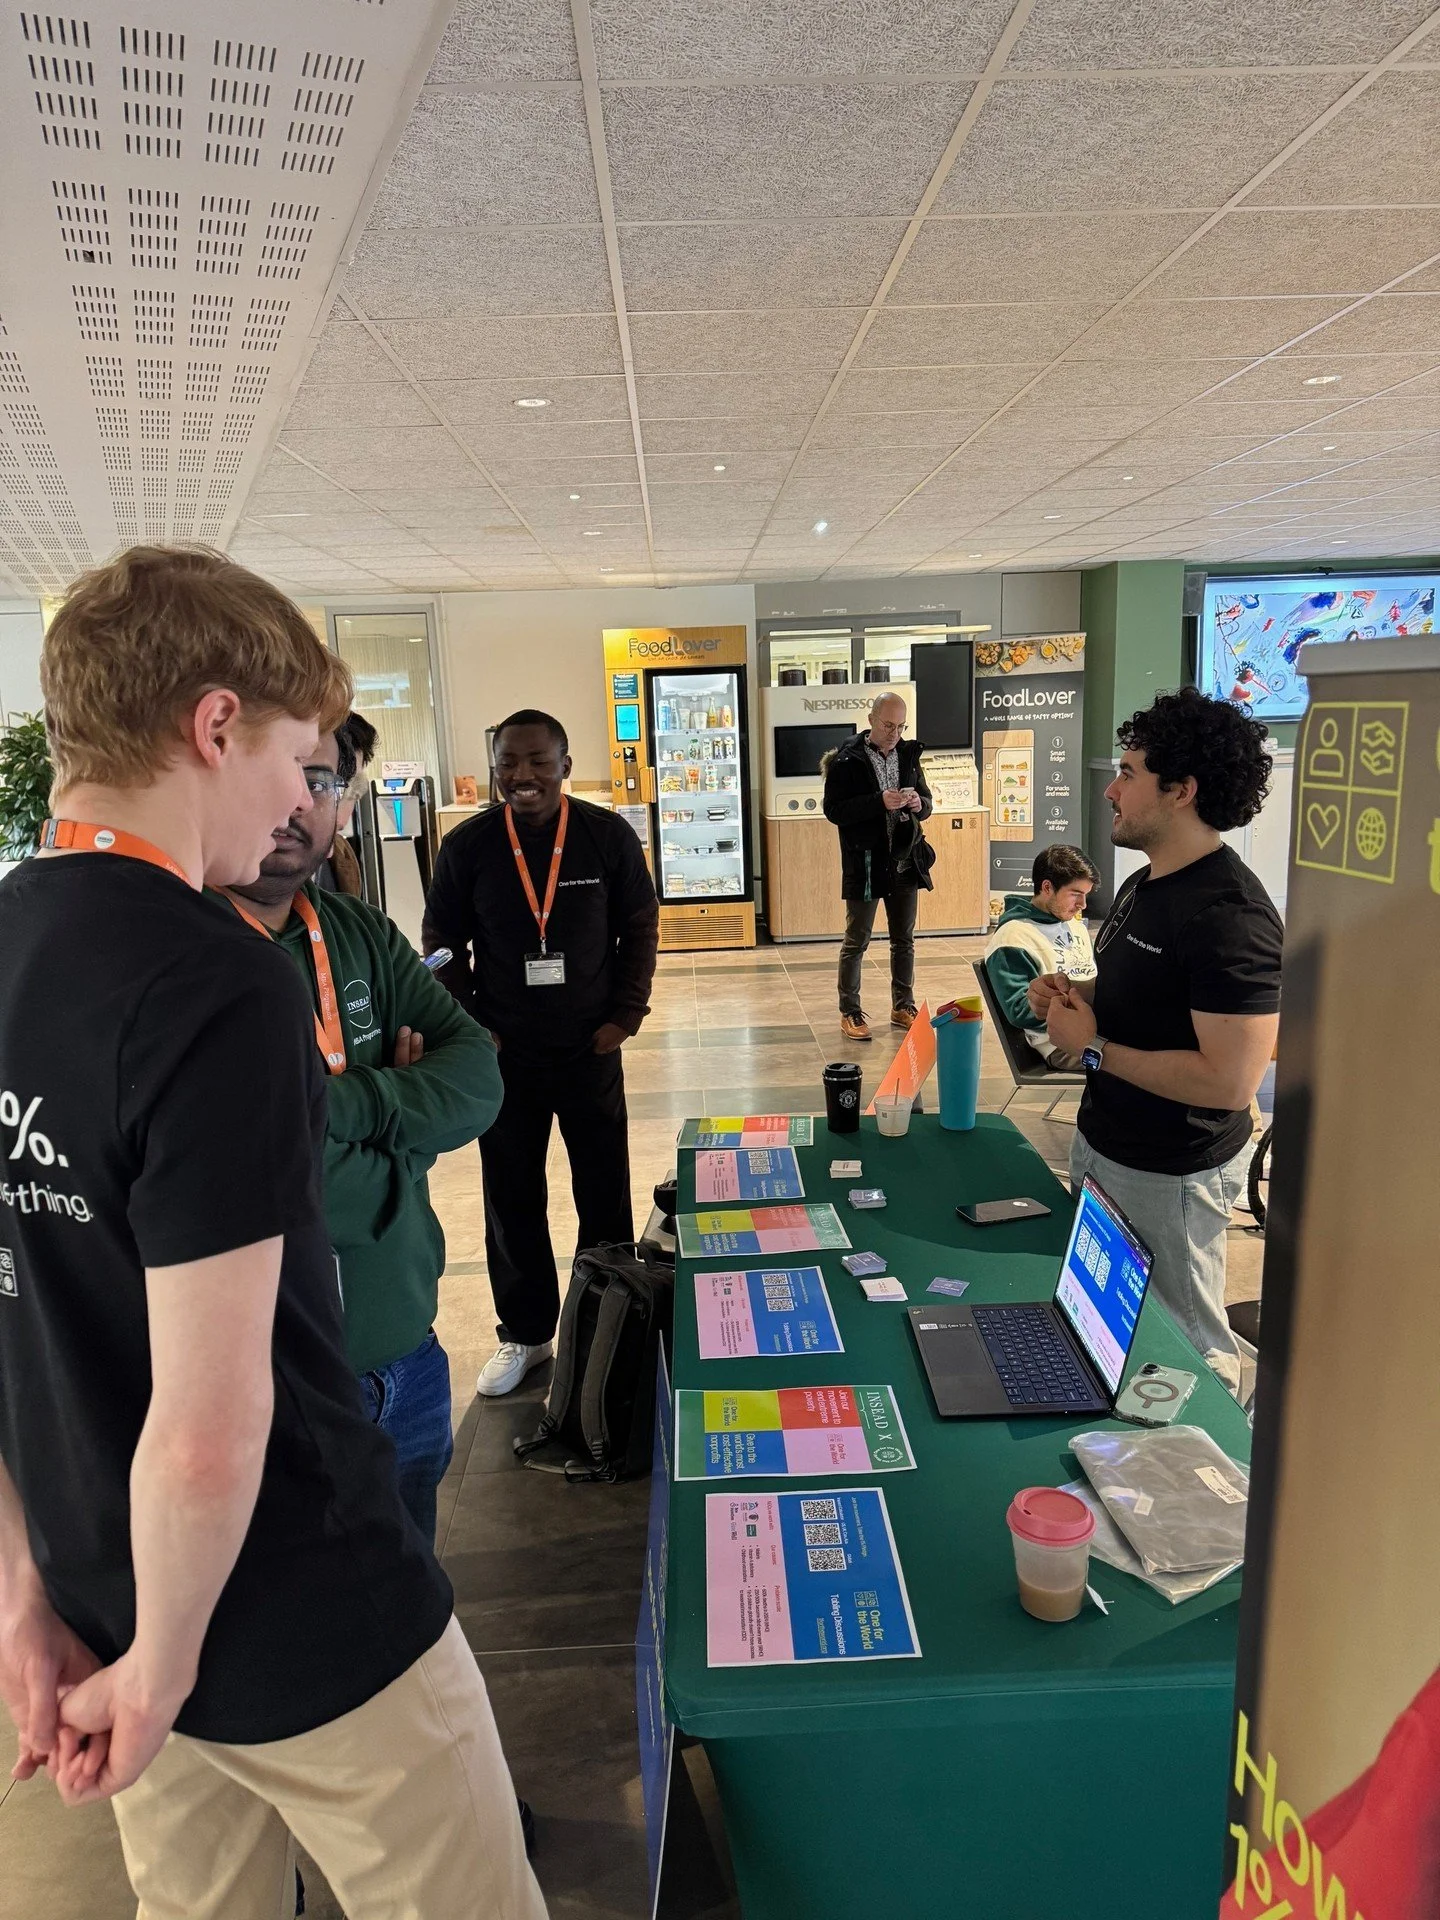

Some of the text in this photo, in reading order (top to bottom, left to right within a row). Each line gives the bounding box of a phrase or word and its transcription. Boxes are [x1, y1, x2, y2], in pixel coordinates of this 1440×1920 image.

[629, 635, 721, 657] FoodLover
[800, 697, 876, 714] NESPRESSO
[983, 688, 1076, 709] FoodLover
[1024, 713, 1032, 721] OF
[1050, 712, 1075, 720] OPTIONS
[1146, 943, 1162, 954] World
[347, 996, 370, 1011] INSEAD
[814, 1207, 832, 1227] INSEAD
[800, 1330, 812, 1349] the World
[810, 1329, 819, 1338] One
[730, 1406, 738, 1415] One
[804, 1391, 816, 1412] poverty
[816, 1391, 830, 1424] end extreme
[827, 1390, 841, 1418] movement
[838, 1390, 850, 1411] Join our
[866, 1391, 889, 1429] INSEAD
[878, 1433, 893, 1441] X
[709, 1435, 721, 1464] nonprofits
[746, 1433, 756, 1446] Give
[837, 1443, 845, 1453] One
[722, 1434, 733, 1474] cost-effective
[735, 1434, 745, 1469] world's most
[748, 1452, 757, 1463] the
[830, 1451, 839, 1465] World
[830, 1594, 847, 1655] Tabling Discussions
[857, 1611, 875, 1650] the World
[869, 1610, 885, 1641] One for
